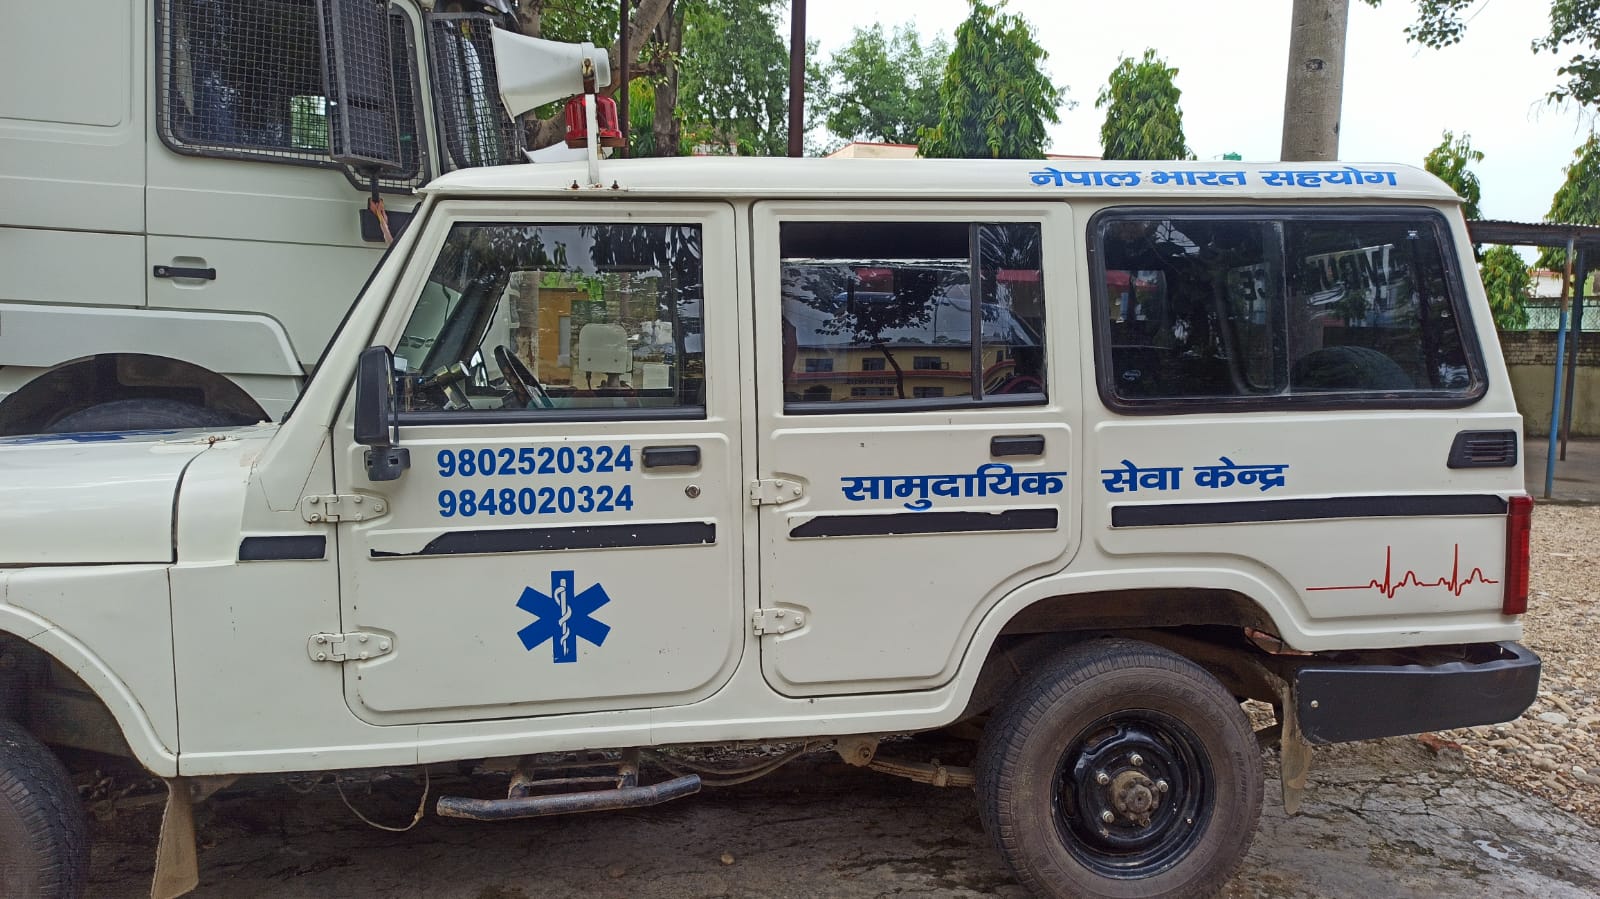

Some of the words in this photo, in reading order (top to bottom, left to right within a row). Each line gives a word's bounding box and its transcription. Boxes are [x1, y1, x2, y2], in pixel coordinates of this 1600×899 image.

[1029, 166, 1142, 188] नेपाल
[1151, 170, 1247, 187] भारत
[1259, 166, 1398, 188] सहयोग
[437, 445, 633, 478] 9802520324
[841, 463, 1067, 512] सामुदायिक
[1101, 459, 1184, 494] सेवा
[1194, 456, 1289, 492] केन्द्र
[437, 485, 634, 518] 9848020324
